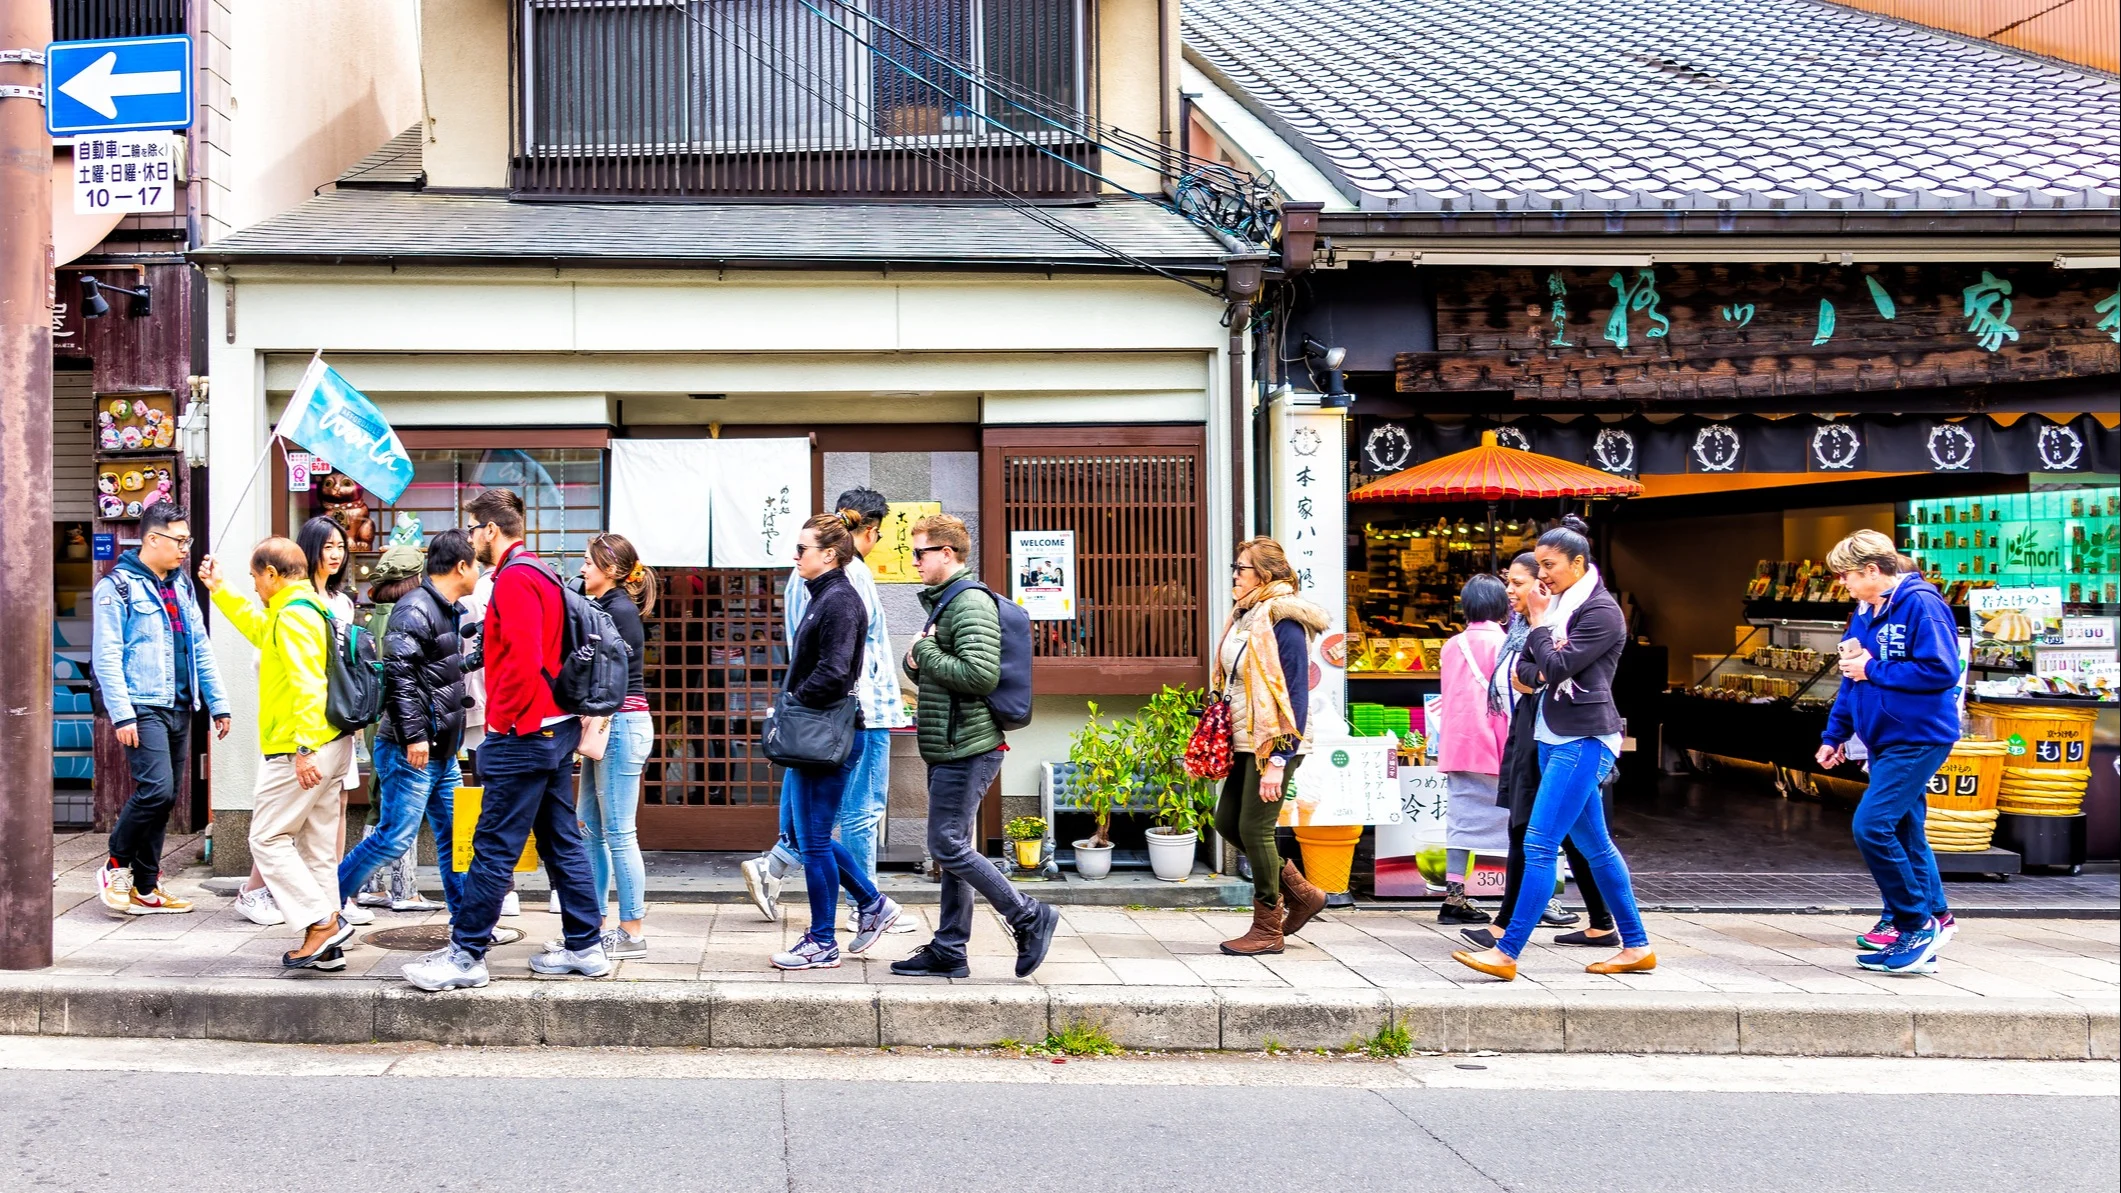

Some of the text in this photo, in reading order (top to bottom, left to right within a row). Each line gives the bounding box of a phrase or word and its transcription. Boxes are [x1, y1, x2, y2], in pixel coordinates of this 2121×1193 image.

[1020, 539, 1065, 547] WELCOME
[2024, 546, 2059, 567] mori
[1889, 623, 1907, 657] CAPE
[2036, 741, 2082, 762] もり
[1939, 765, 1972, 773] つけもの
